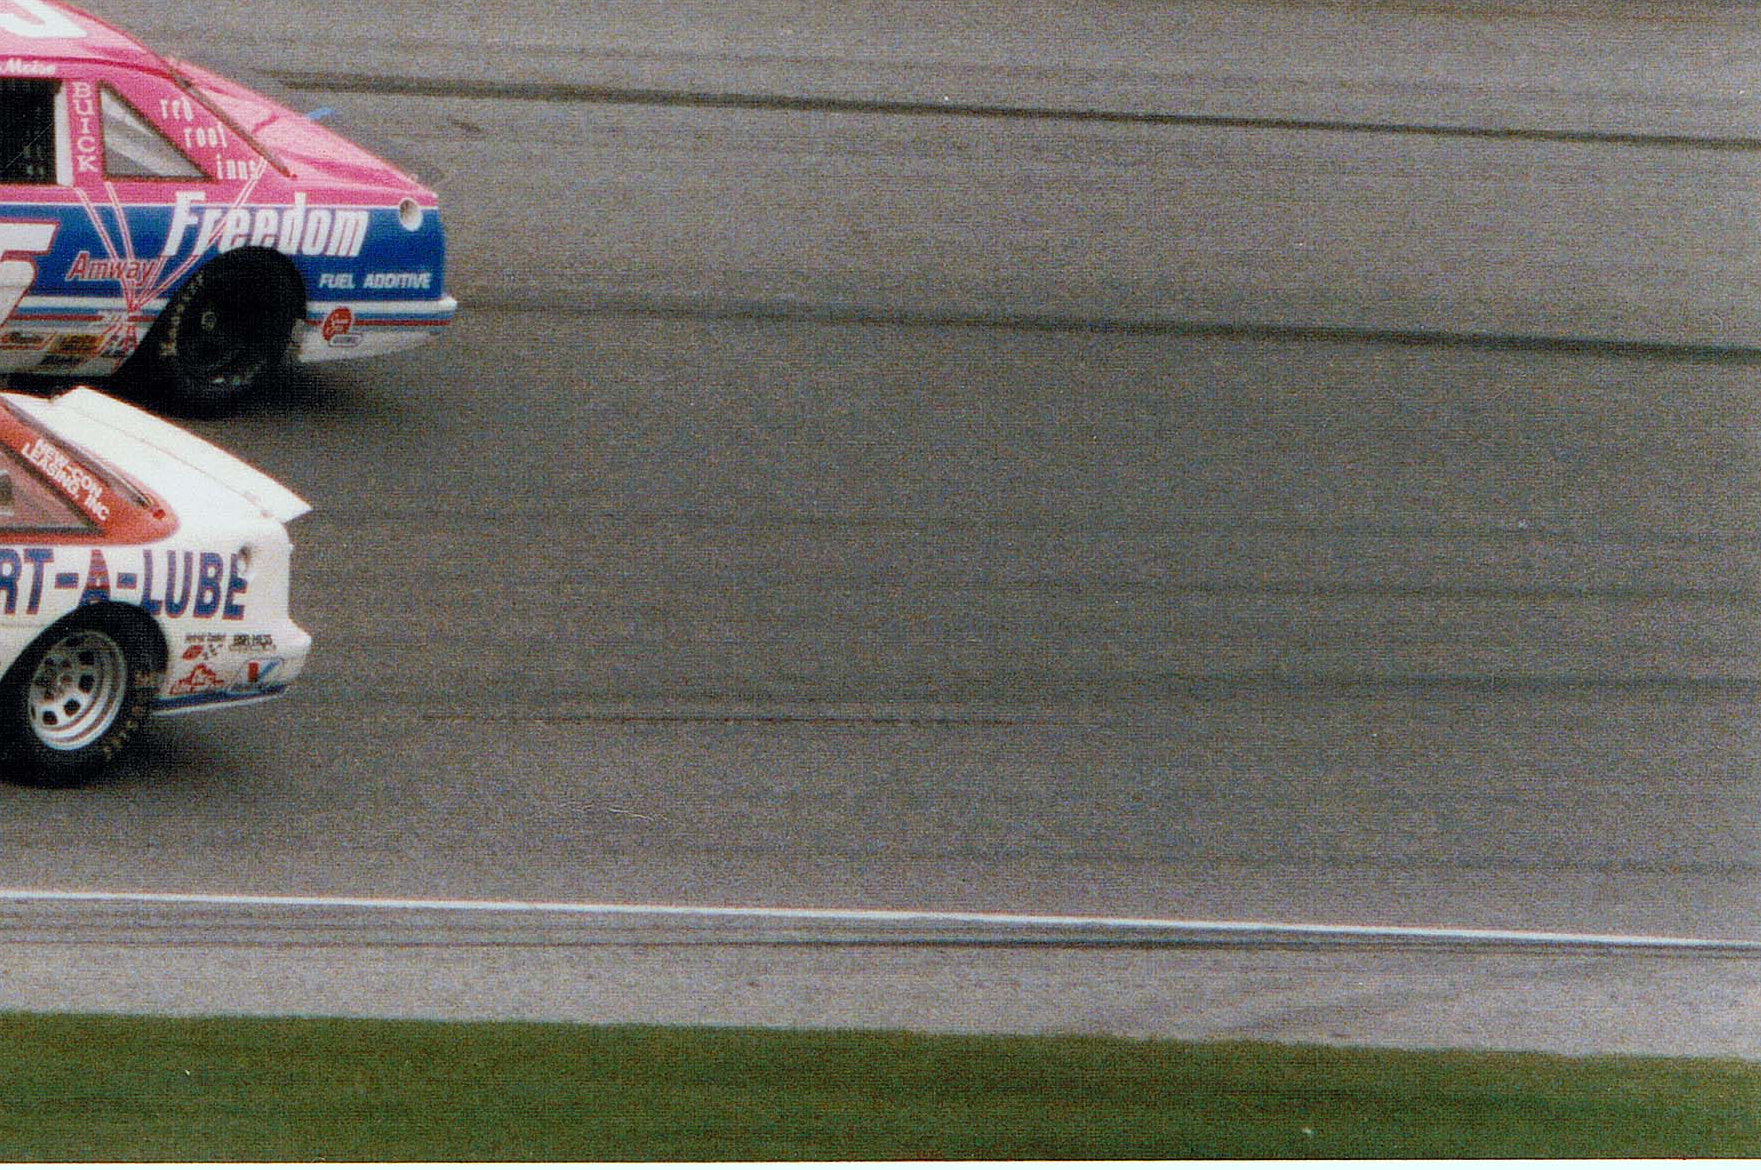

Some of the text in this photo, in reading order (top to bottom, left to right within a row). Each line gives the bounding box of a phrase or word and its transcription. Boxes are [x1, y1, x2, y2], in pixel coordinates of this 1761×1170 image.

[72, 81, 100, 174] BUICK
[169, 191, 370, 258] Freedom
[64, 250, 157, 287] Amway
[318, 272, 432, 289] FUEL ADDITIVE
